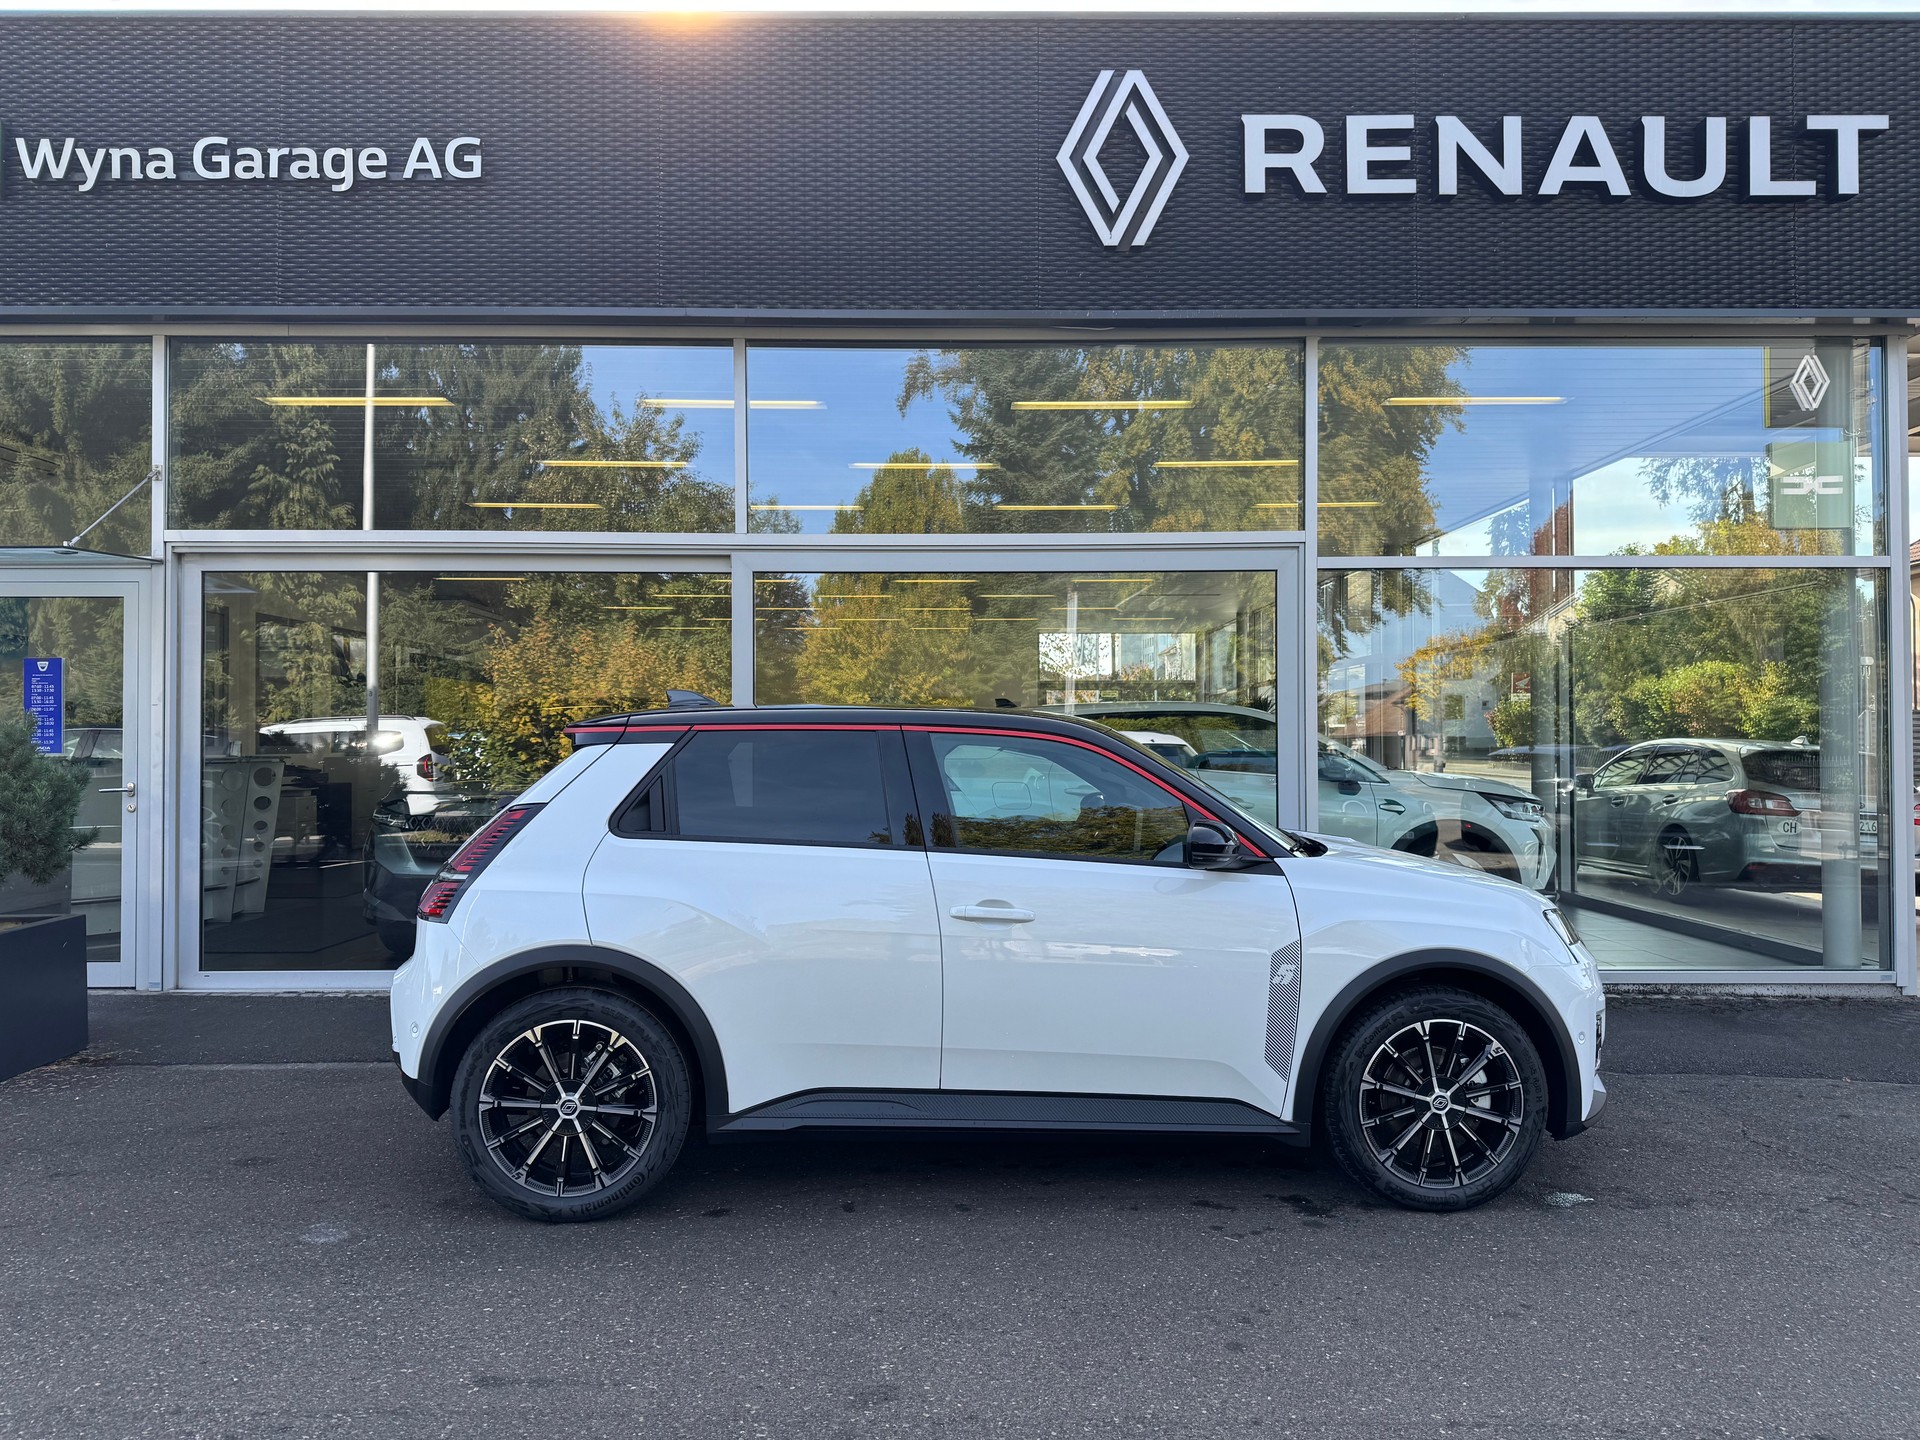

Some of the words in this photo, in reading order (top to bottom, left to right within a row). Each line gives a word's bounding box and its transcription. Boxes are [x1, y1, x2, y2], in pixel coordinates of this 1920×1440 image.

[15, 137, 176, 192] Wyna
[193, 136, 387, 192] Garage
[403, 137, 483, 179] AG
[1241, 114, 1890, 197] RENAULT
[1782, 821, 1798, 834] CH
